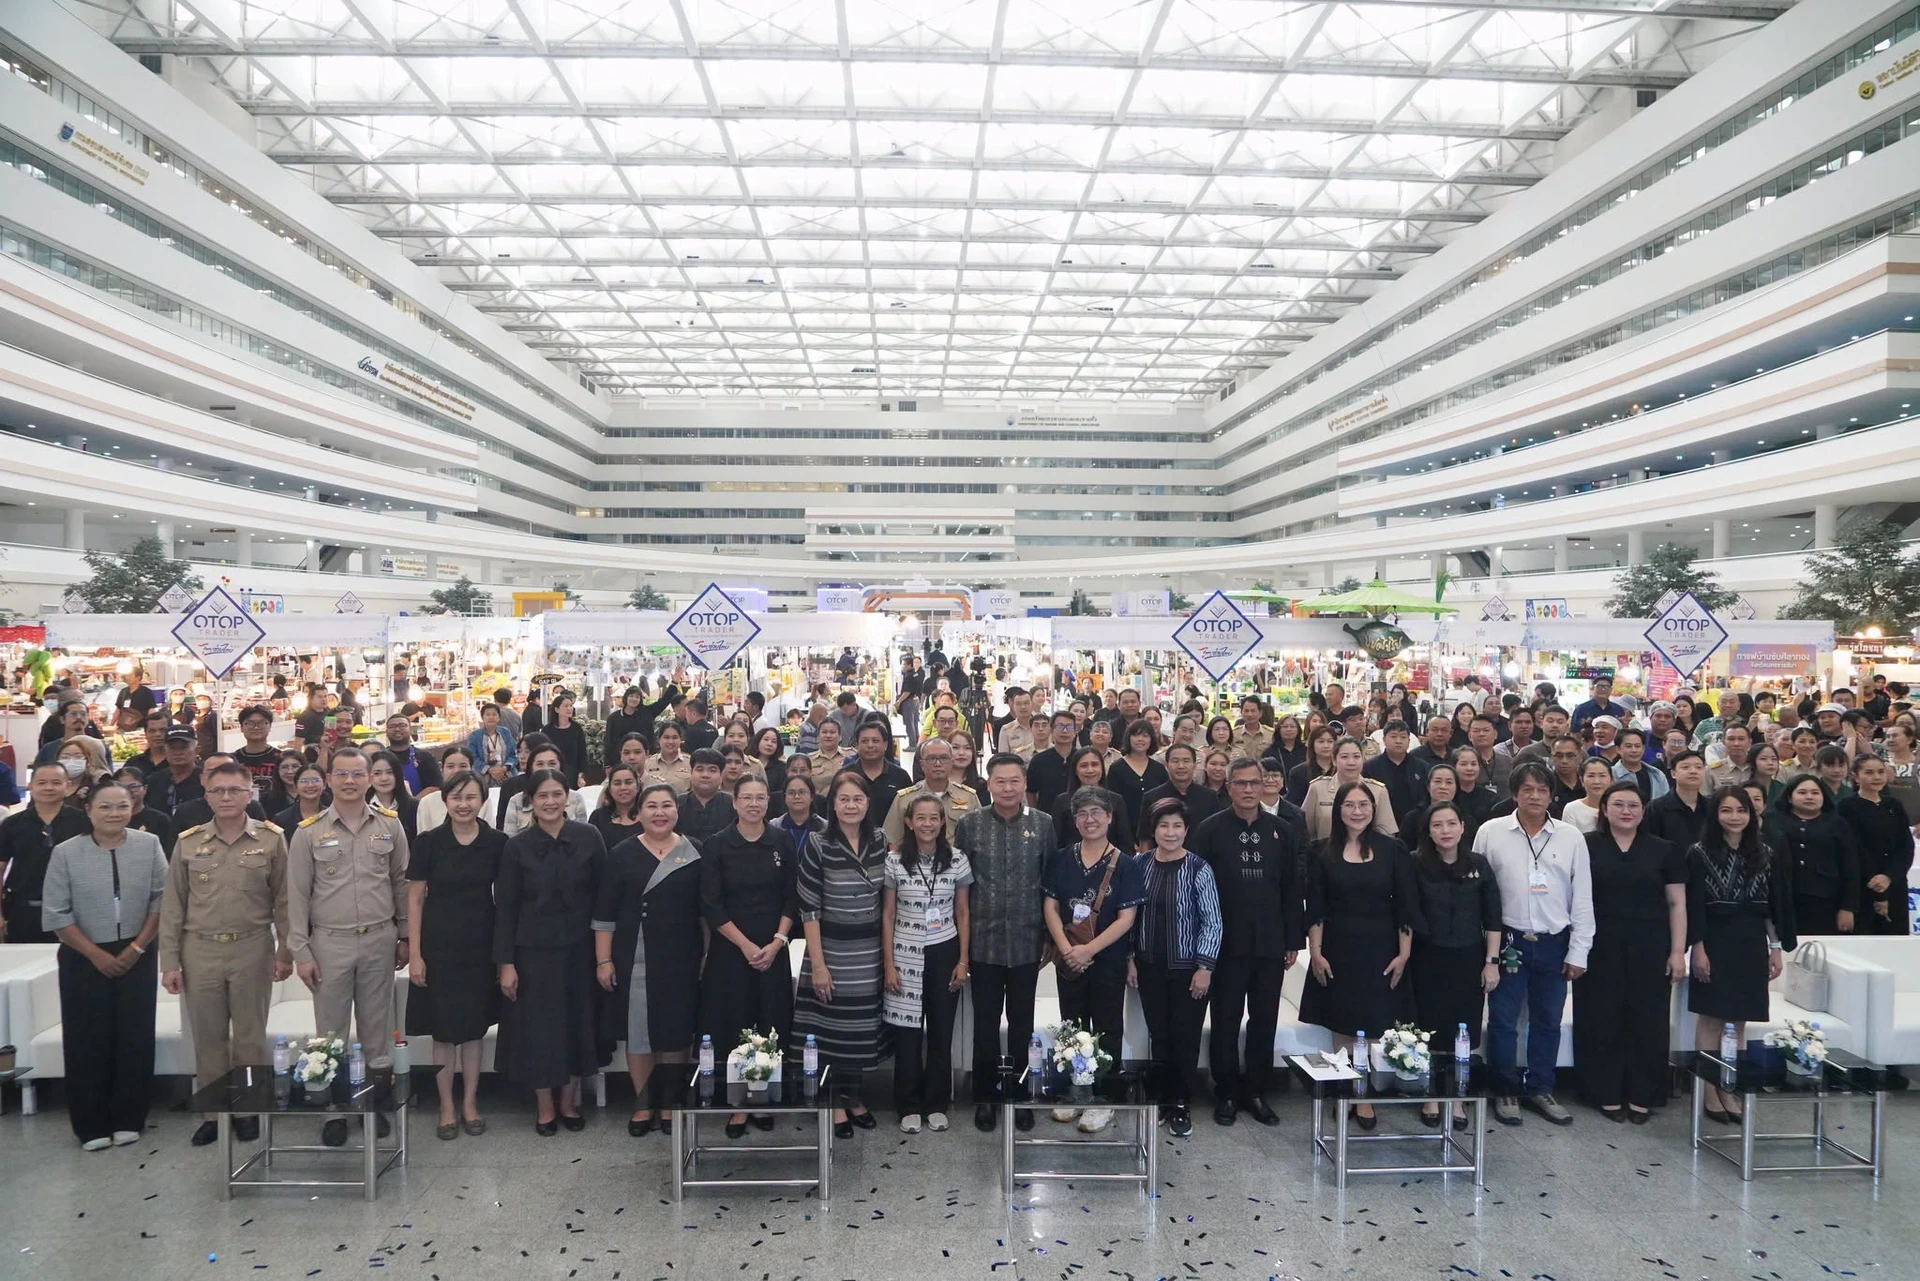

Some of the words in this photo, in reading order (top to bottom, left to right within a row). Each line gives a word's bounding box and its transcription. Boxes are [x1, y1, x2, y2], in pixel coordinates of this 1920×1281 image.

[193, 615, 244, 629] OTOP
[688, 612, 739, 626] OTOP
[1193, 619, 1243, 632] OTOP
[1664, 619, 1710, 631] OTOP
